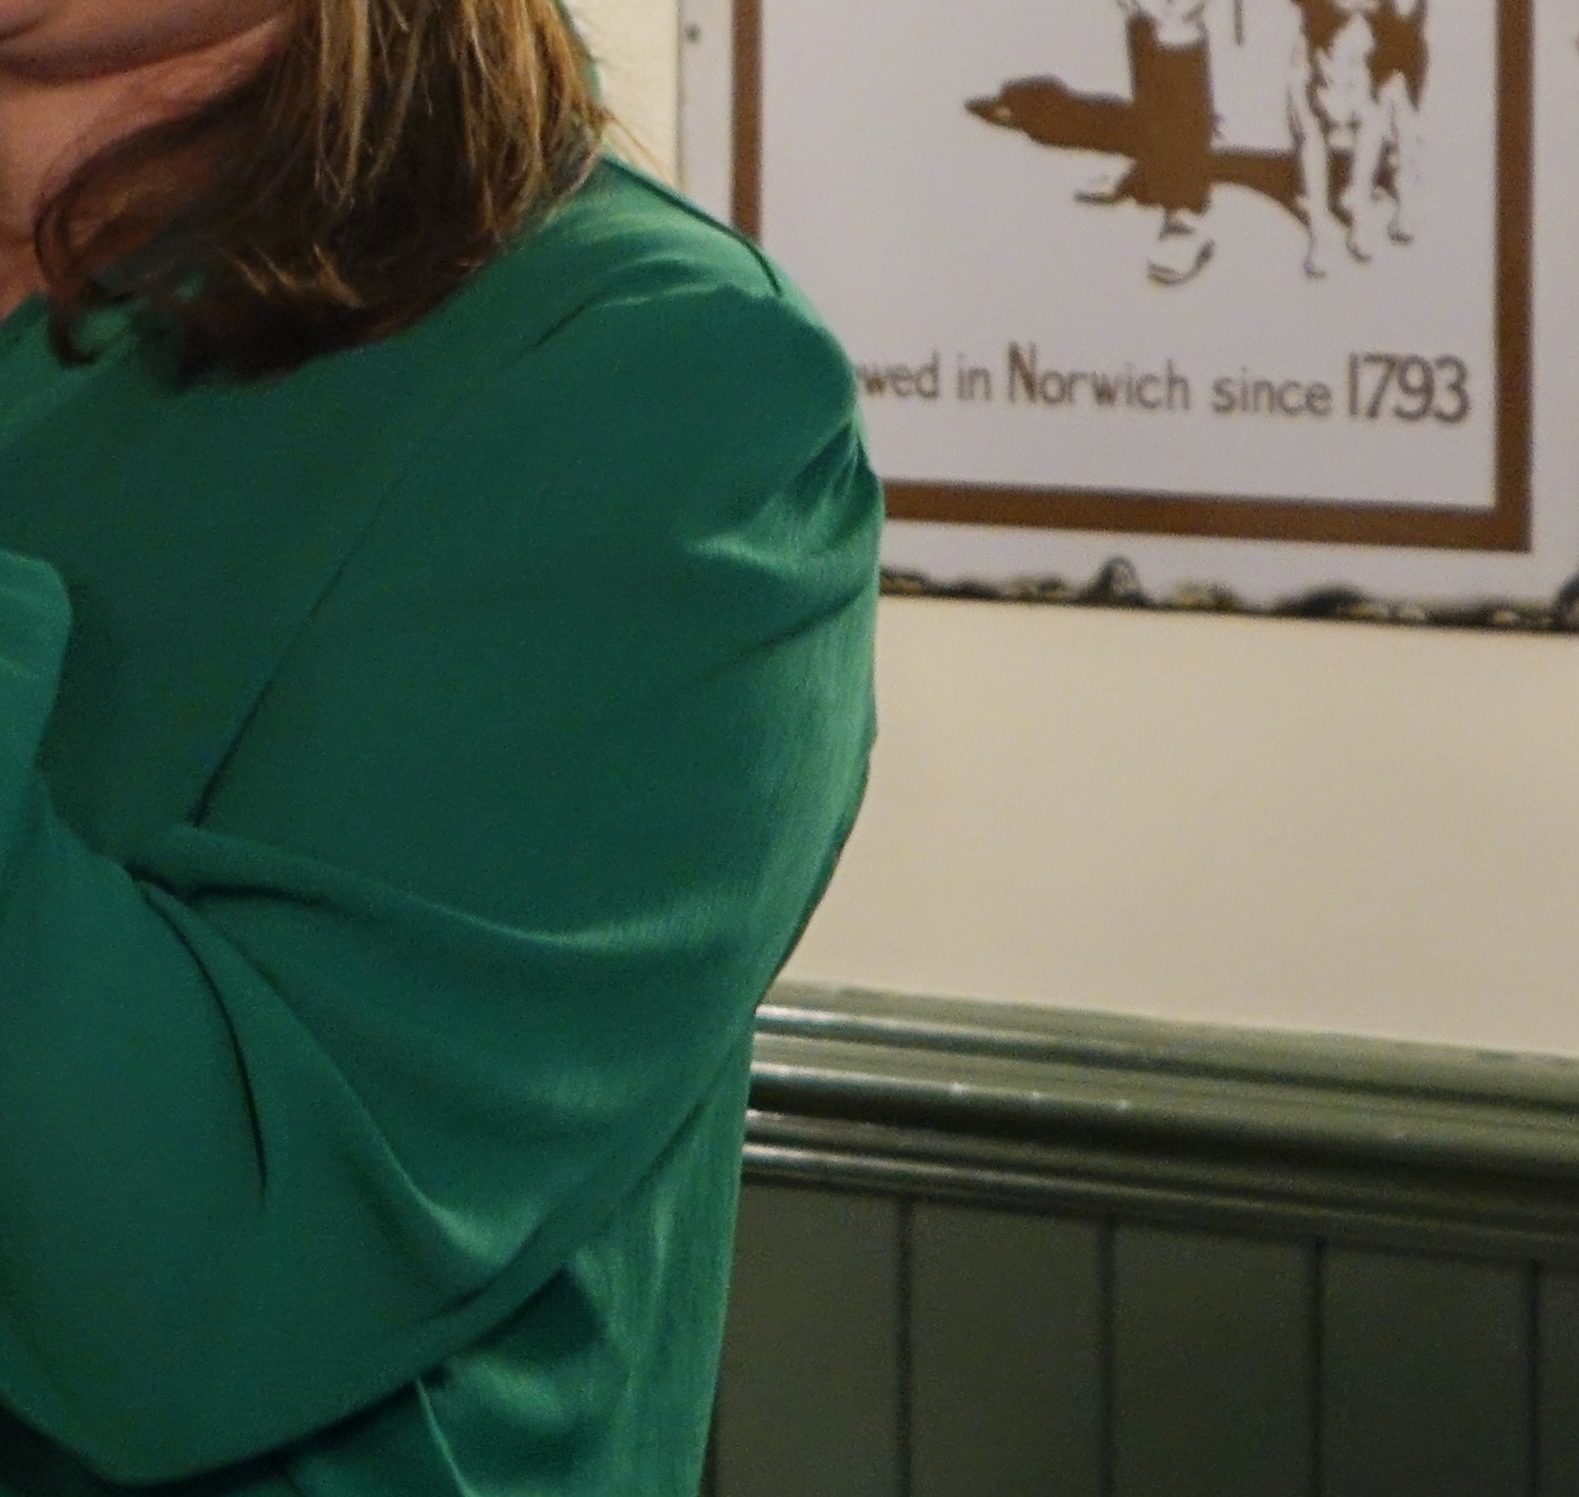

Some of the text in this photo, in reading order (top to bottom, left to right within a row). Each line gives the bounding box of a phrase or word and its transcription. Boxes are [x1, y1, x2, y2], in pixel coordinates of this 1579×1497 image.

[957, 353, 993, 403] in
[1008, 341, 1190, 414] Norwich
[1212, 369, 1334, 418] since
[1347, 351, 1473, 423] 1793
